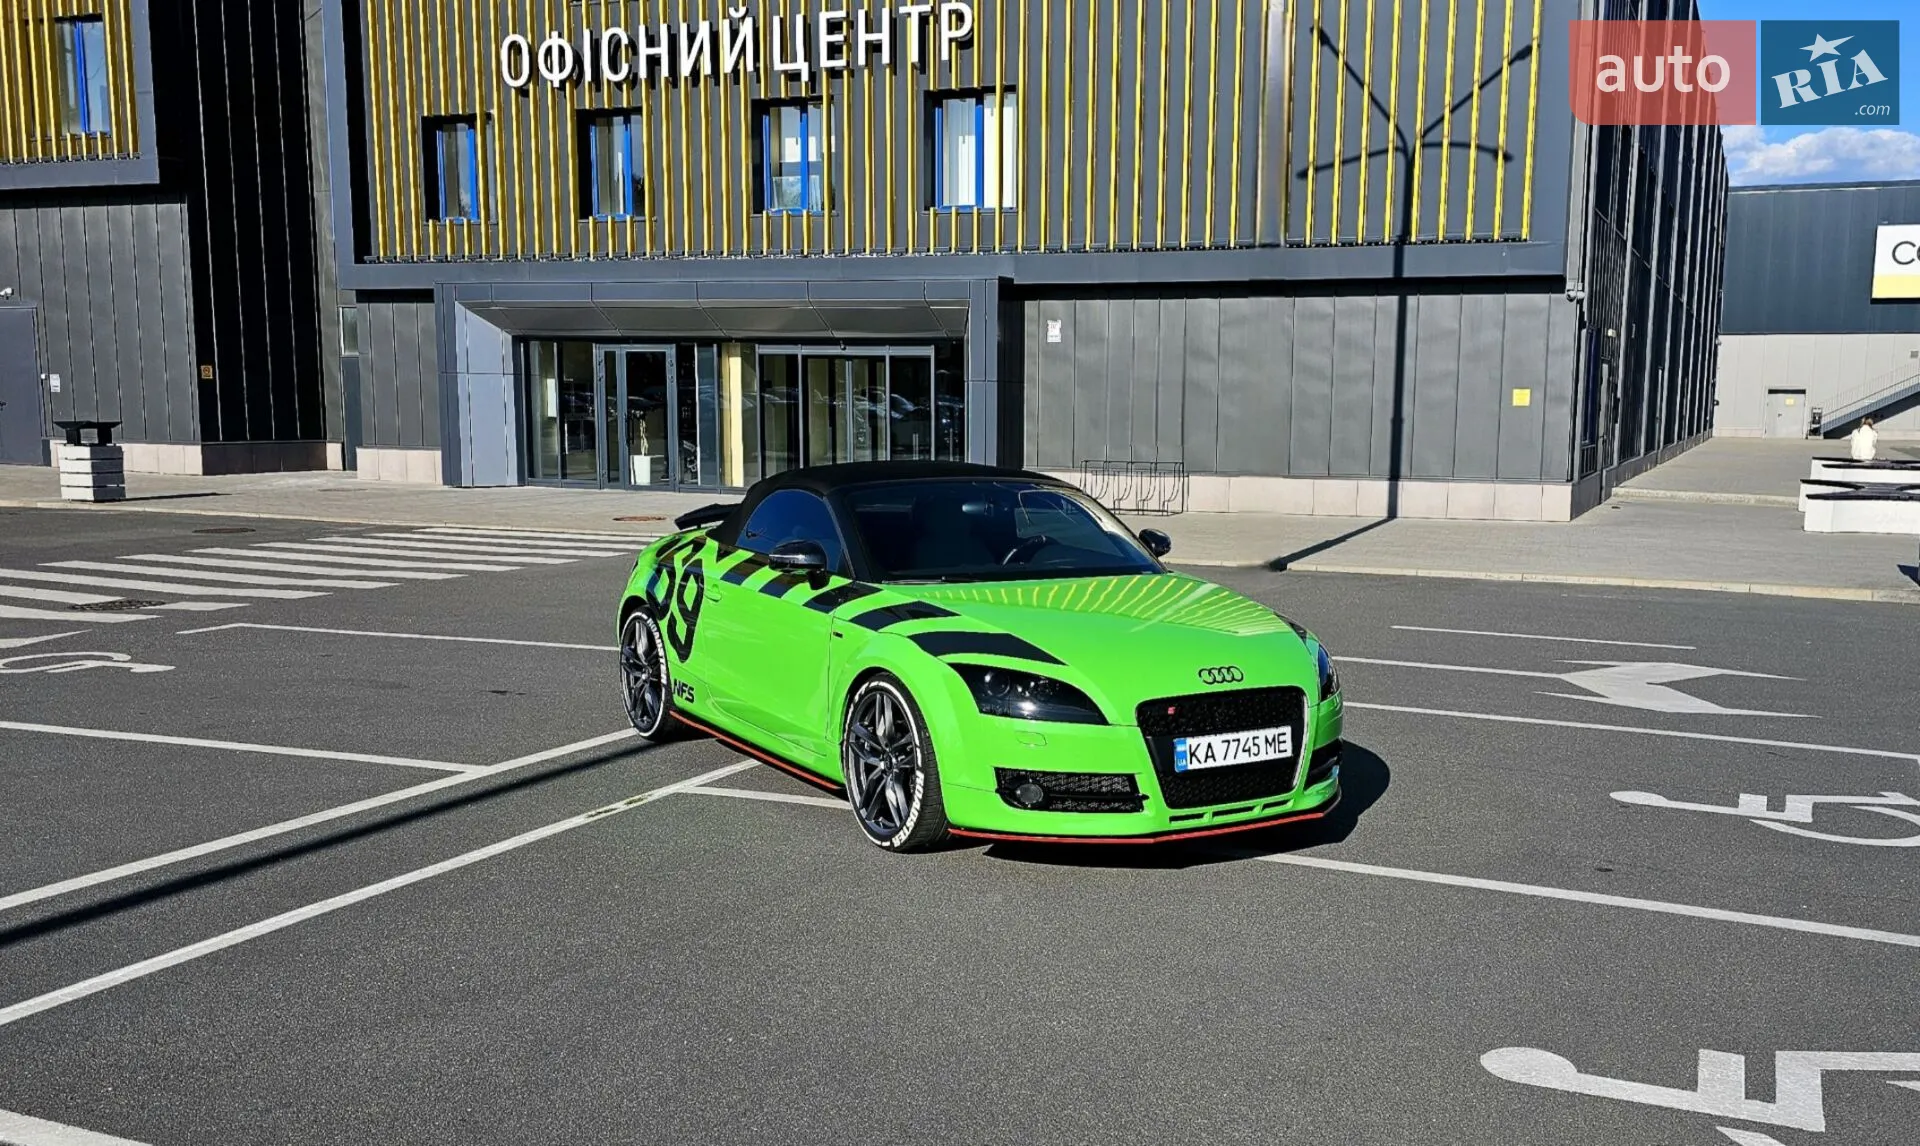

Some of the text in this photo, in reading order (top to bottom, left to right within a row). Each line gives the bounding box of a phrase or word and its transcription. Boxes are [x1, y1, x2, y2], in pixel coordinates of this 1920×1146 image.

[500, 1, 975, 88] ОФІСНИЙ ЦЕНТР
[646, 618, 667, 685] ROADSTER
[673, 679, 695, 704] NFS
[1221, 736, 1260, 761] 7745
[1265, 733, 1287, 755] ME
[891, 769, 925, 848] ROADSTER
